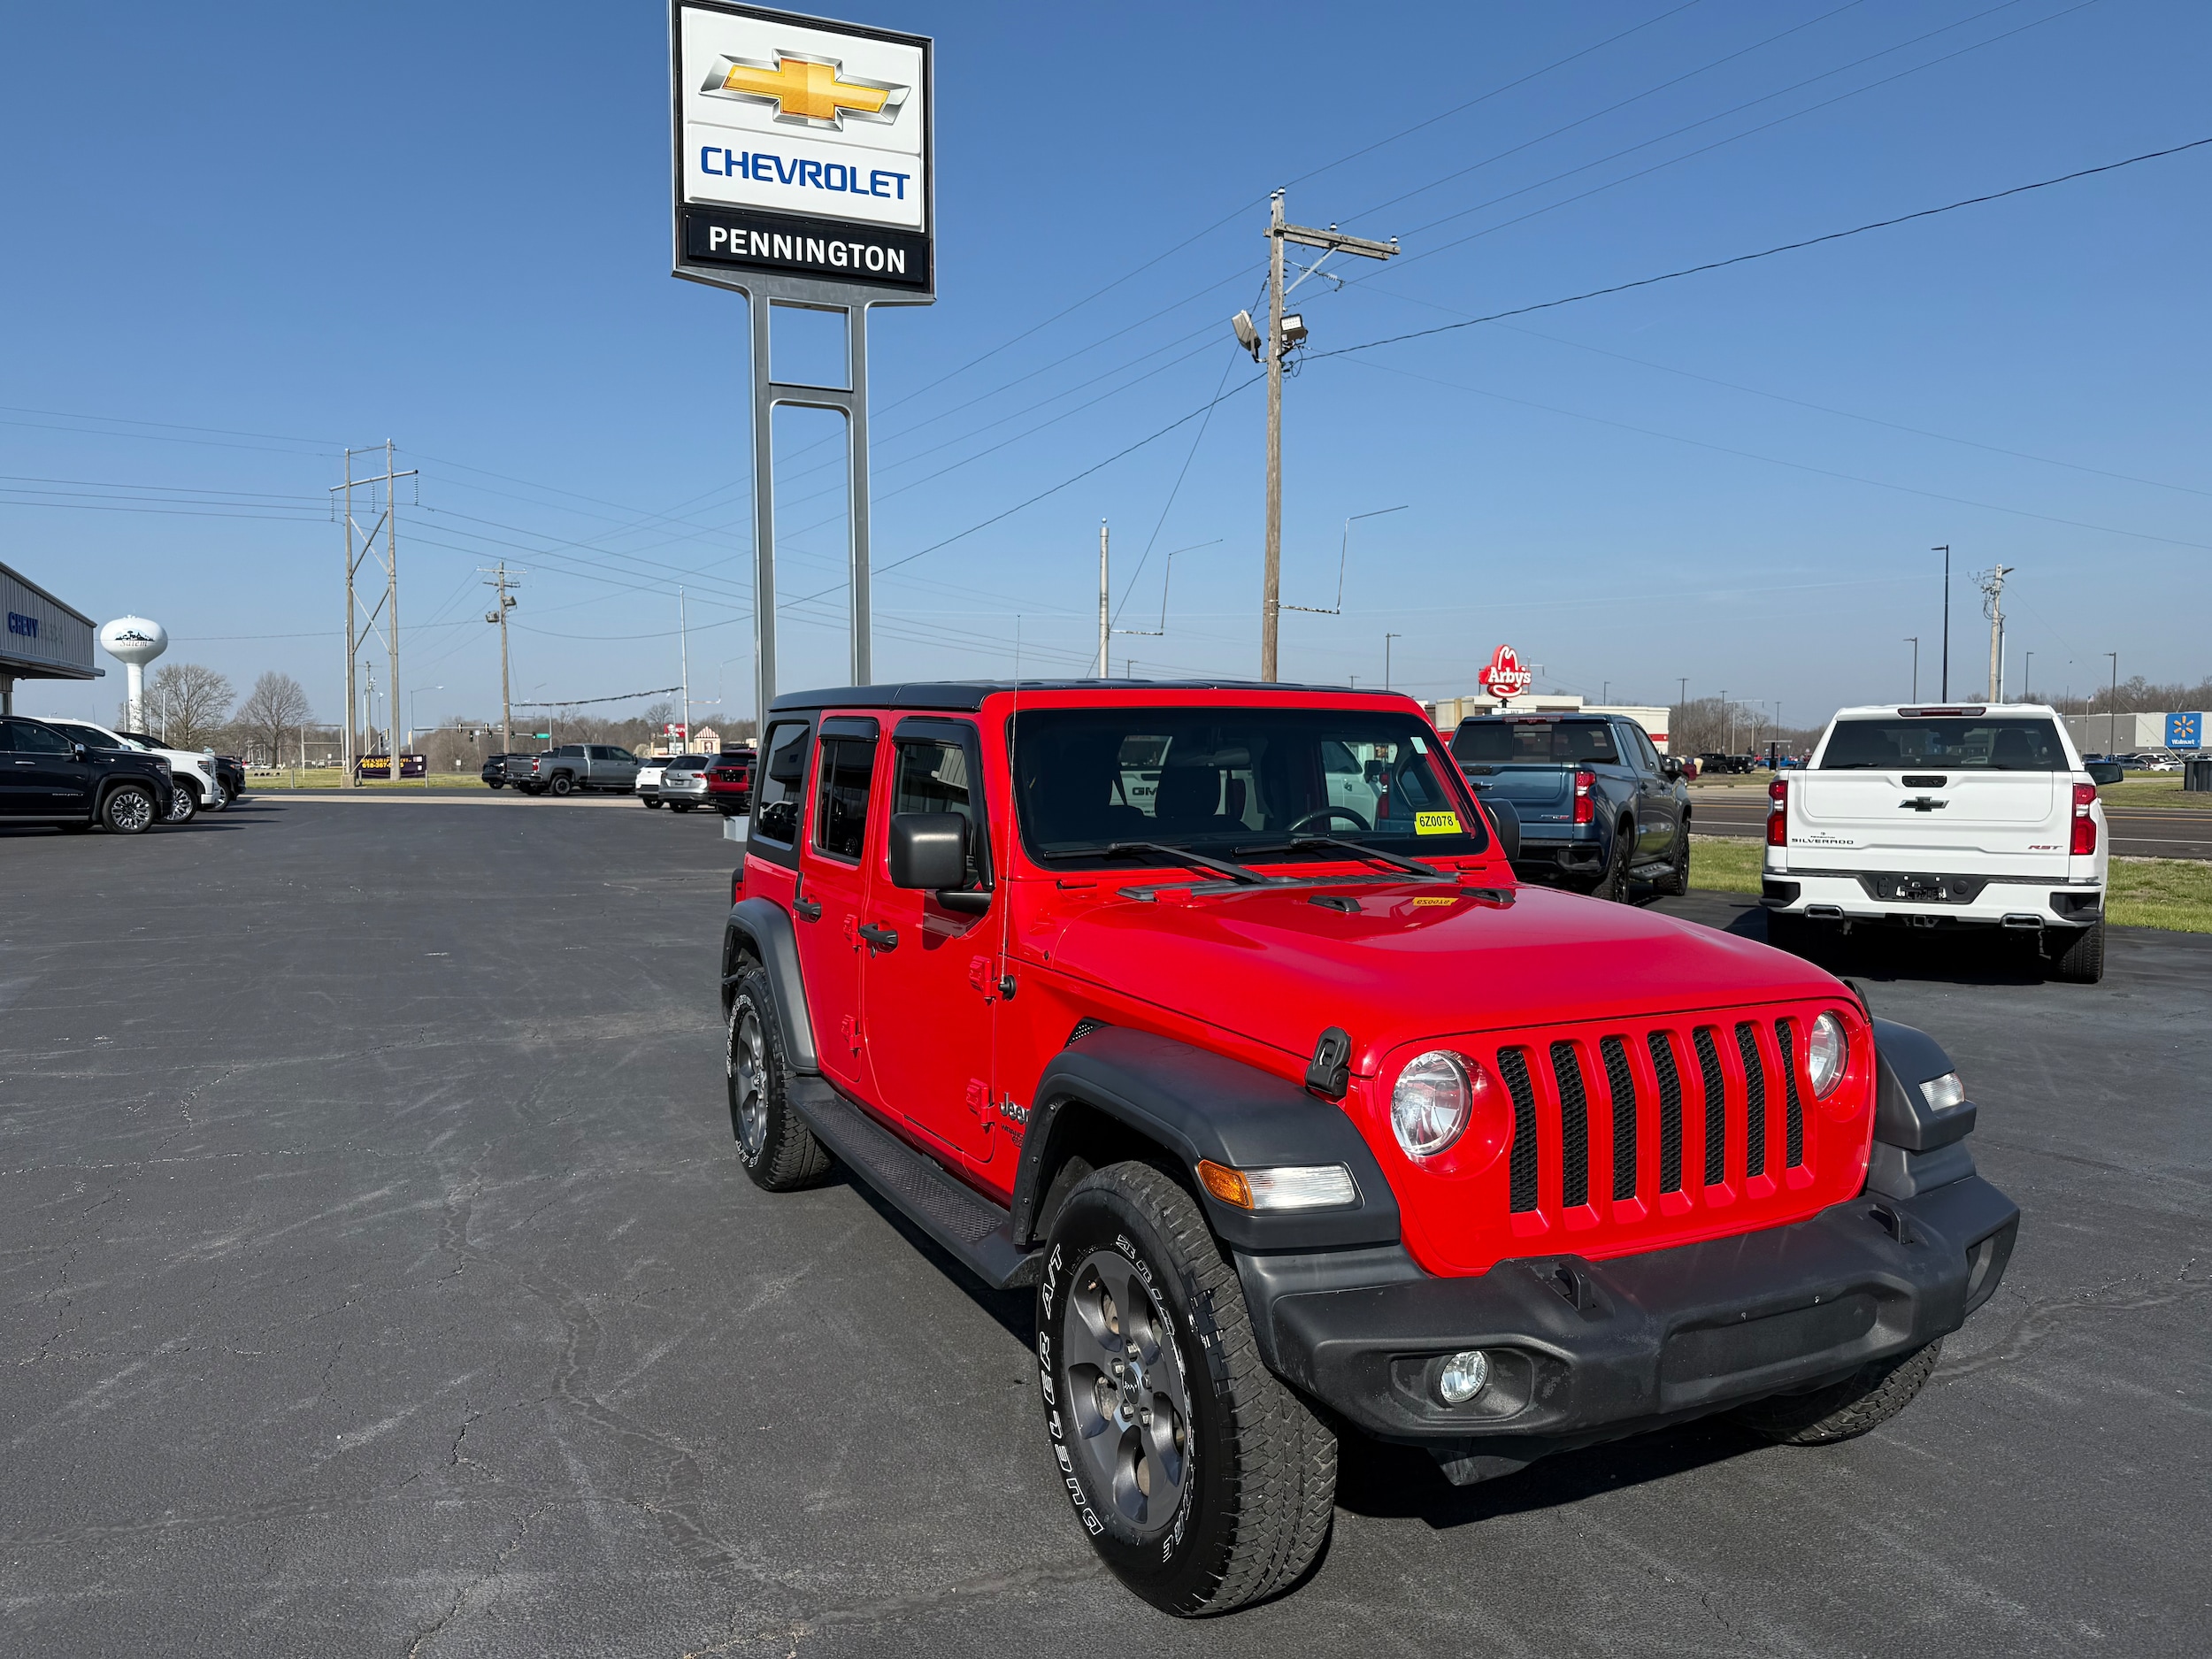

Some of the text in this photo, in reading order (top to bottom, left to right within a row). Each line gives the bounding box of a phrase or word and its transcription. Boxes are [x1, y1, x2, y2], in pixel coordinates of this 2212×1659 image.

[701, 146, 910, 200] CHEVROLET
[709, 226, 906, 274] PENNINGTON
[8, 611, 39, 639] CHEVY
[1488, 666, 1532, 688] Arby's
[1133, 787, 1157, 795] GM
[1419, 816, 1454, 827] 6Z0078
[1039, 1243, 1105, 1536] DUELER A/T
